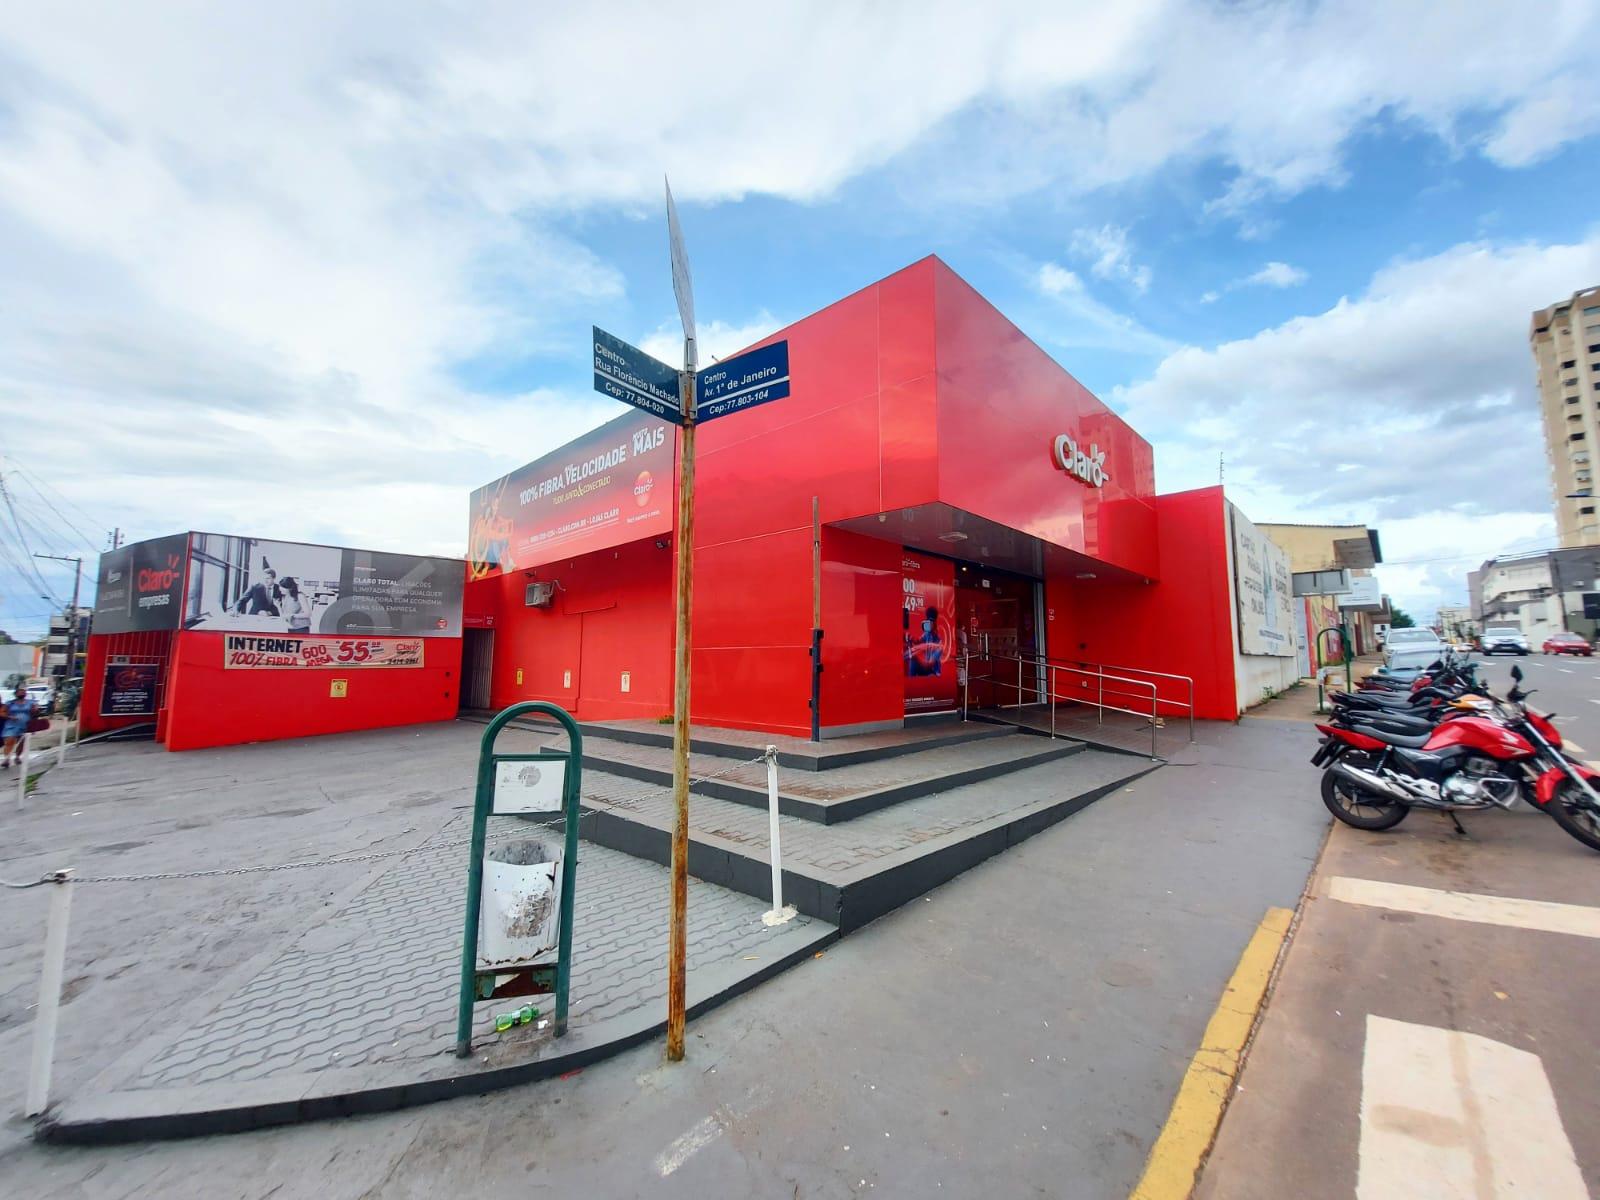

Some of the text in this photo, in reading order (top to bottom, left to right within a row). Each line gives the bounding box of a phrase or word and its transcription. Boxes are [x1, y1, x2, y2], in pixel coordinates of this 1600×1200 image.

[595, 343, 625, 366] Centro
[595, 357, 680, 405] Rua Florêncio Machado
[704, 371, 727, 385] Centro
[704, 387, 715, 398] Av.
[727, 378, 738, 390] de
[741, 366, 777, 389] Janeiro
[605, 382, 625, 398] Cep:
[520, 485, 539, 506] 100%
[565, 445, 626, 486] VELOCIDADE
[633, 427, 665, 456] MAIS
[1054, 434, 1109, 488] Claro
[138, 563, 179, 592] Claro
[353, 577, 377, 585] CLARO
[229, 636, 303, 653] INTERNET
[302, 645, 327, 660] 600
[229, 651, 298, 668] 100% FIBRA
